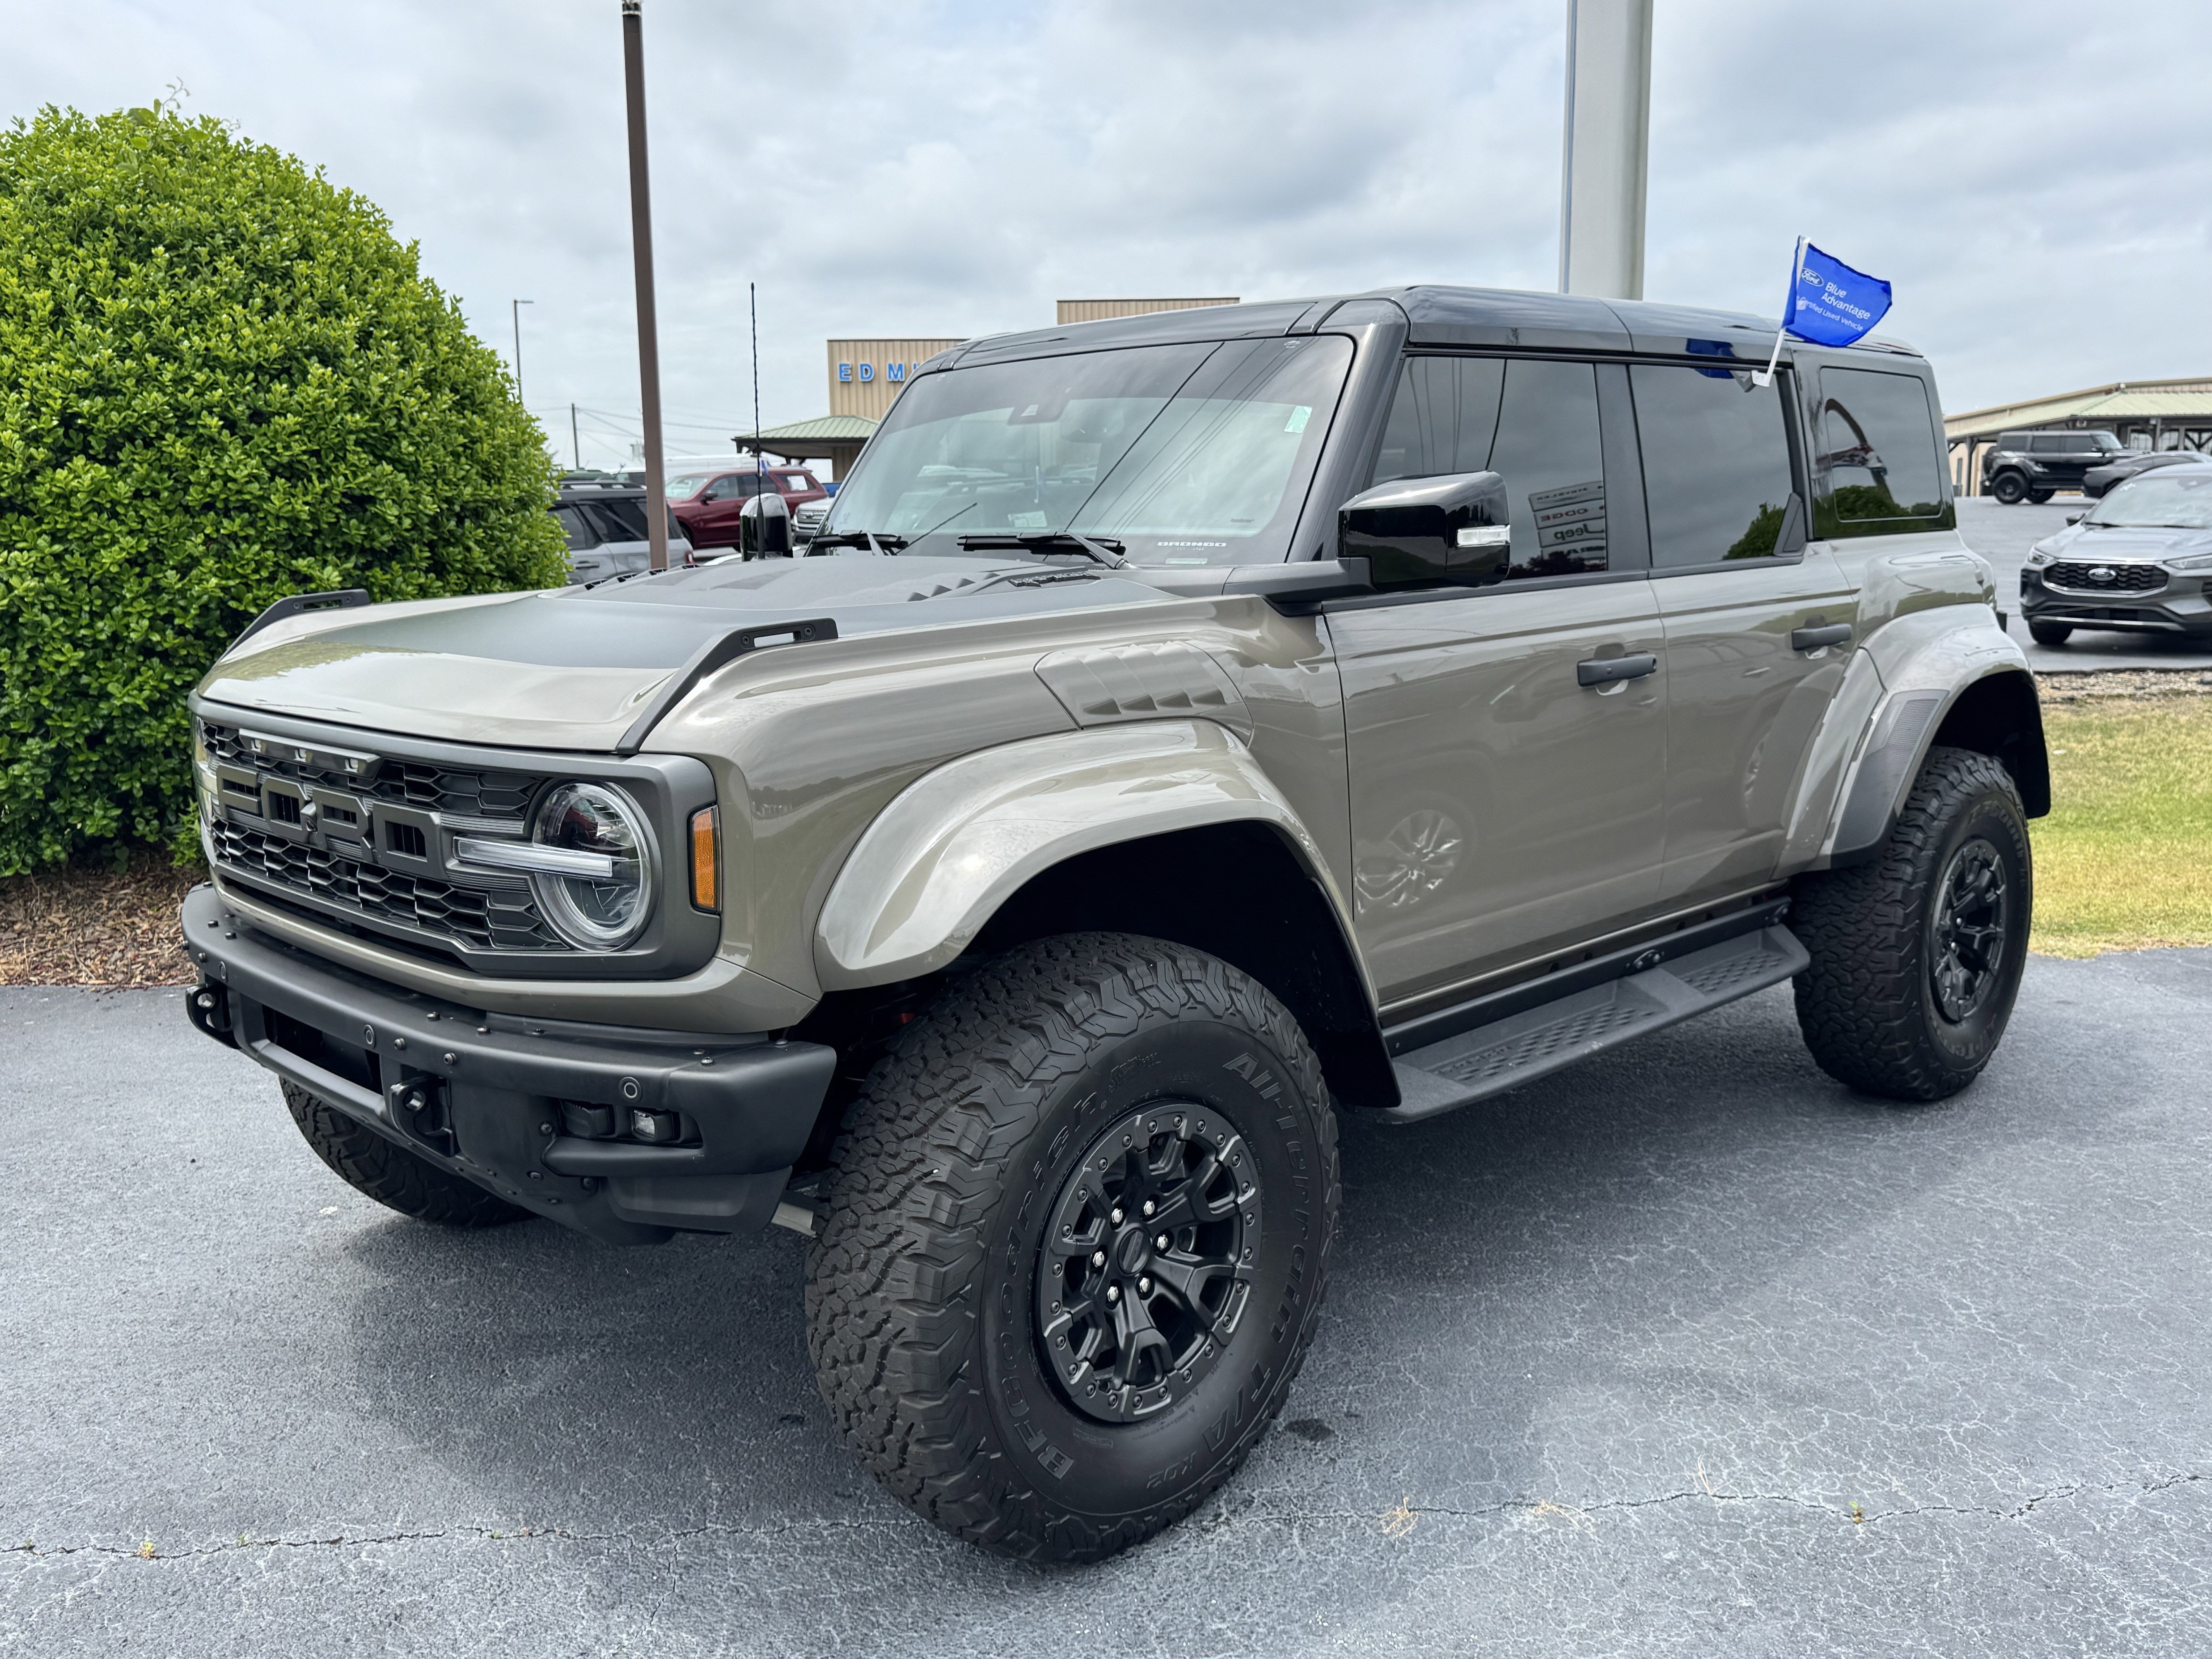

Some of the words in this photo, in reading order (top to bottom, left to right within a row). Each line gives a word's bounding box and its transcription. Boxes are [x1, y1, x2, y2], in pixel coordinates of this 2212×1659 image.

[1821, 292, 1870, 319] Advantage
[1822, 309, 1841, 321] Used
[1825, 282, 1847, 298] Blue
[838, 362, 874, 381] ED
[216, 764, 449, 884] FORD
[1222, 1053, 1310, 1344] All-Terrain
[999, 1090, 1099, 1481] BFGoodrich
[1202, 1358, 1271, 1452] T/A
